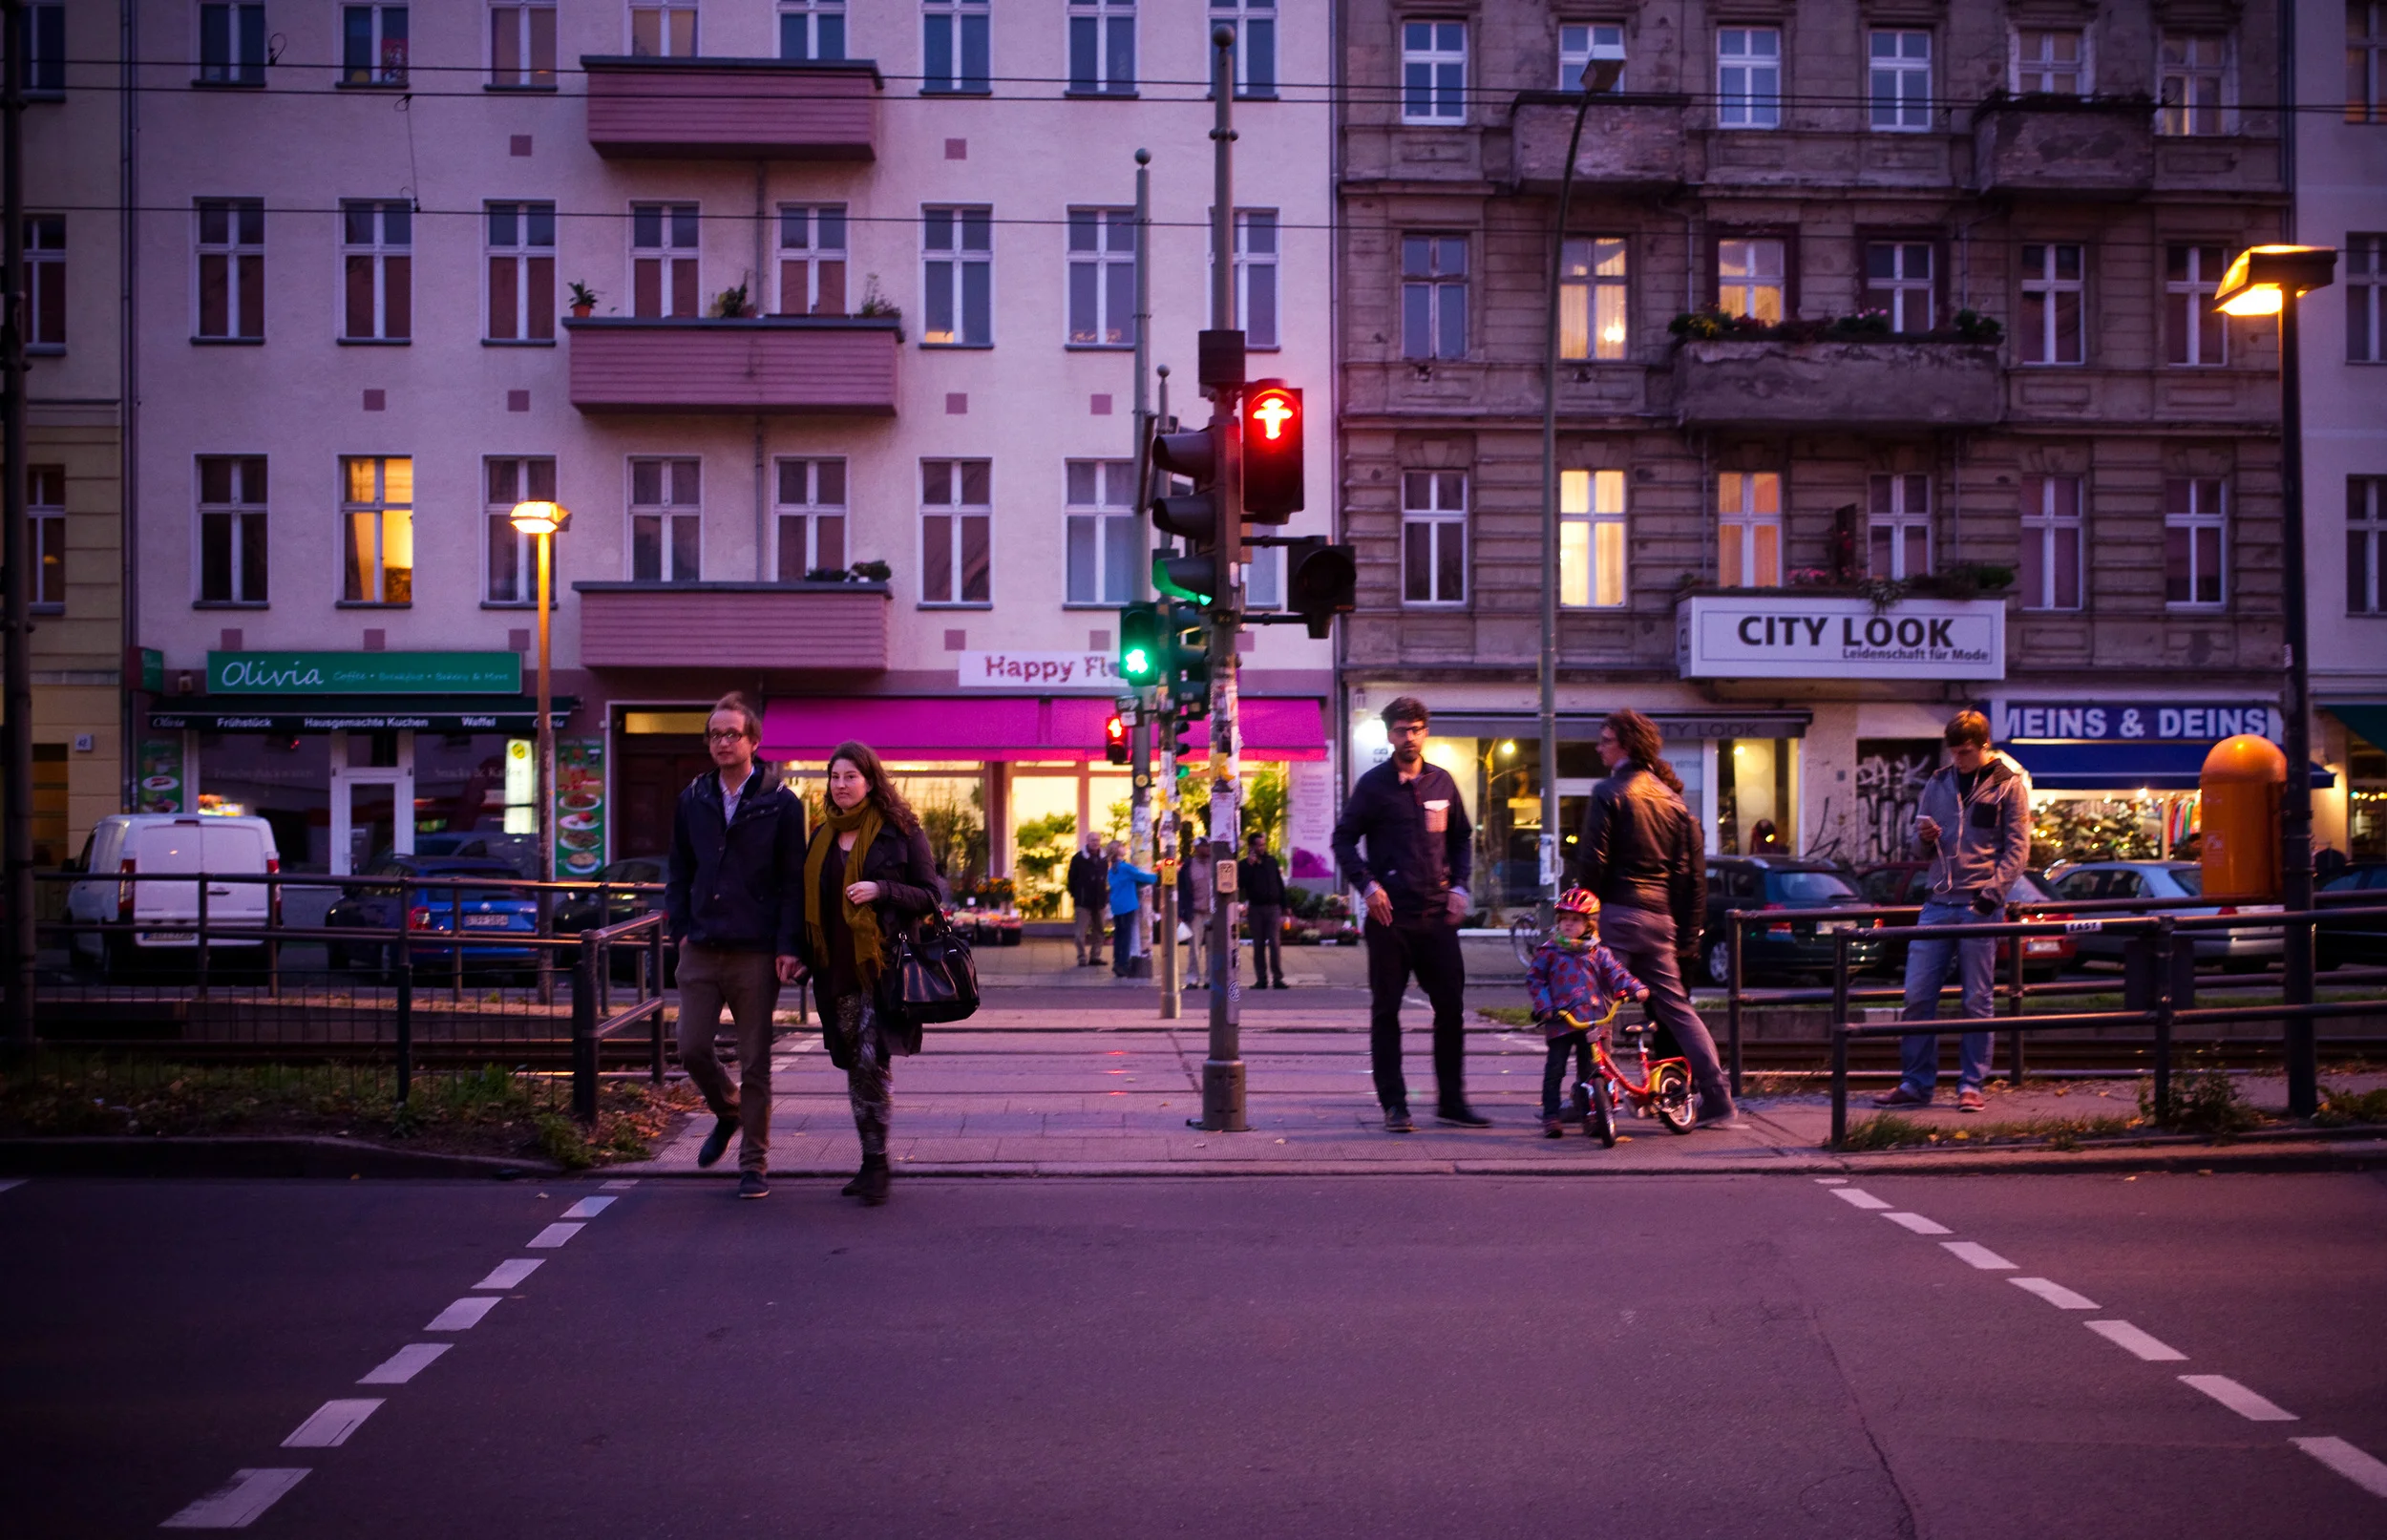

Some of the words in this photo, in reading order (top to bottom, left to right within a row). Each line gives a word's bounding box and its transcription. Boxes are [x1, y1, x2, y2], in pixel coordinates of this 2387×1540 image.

[1738, 616, 1828, 646] CITY
[1843, 618, 1954, 648] LOOK
[1843, 648, 1926, 661] Leidenschaft
[1952, 650, 1988, 662] Mode
[222, 661, 325, 686] Olivia
[984, 655, 1074, 683] Happy
[217, 716, 273, 728] Frühstück
[304, 717, 386, 729] Hausgemachte
[387, 717, 430, 728] Kuchen
[461, 716, 497, 728] Waffel
[1696, 723, 1760, 737] LOOK
[2120, 708, 2146, 738] &
[2159, 708, 2267, 738] DEINS
[2069, 922, 2098, 932] EAST
